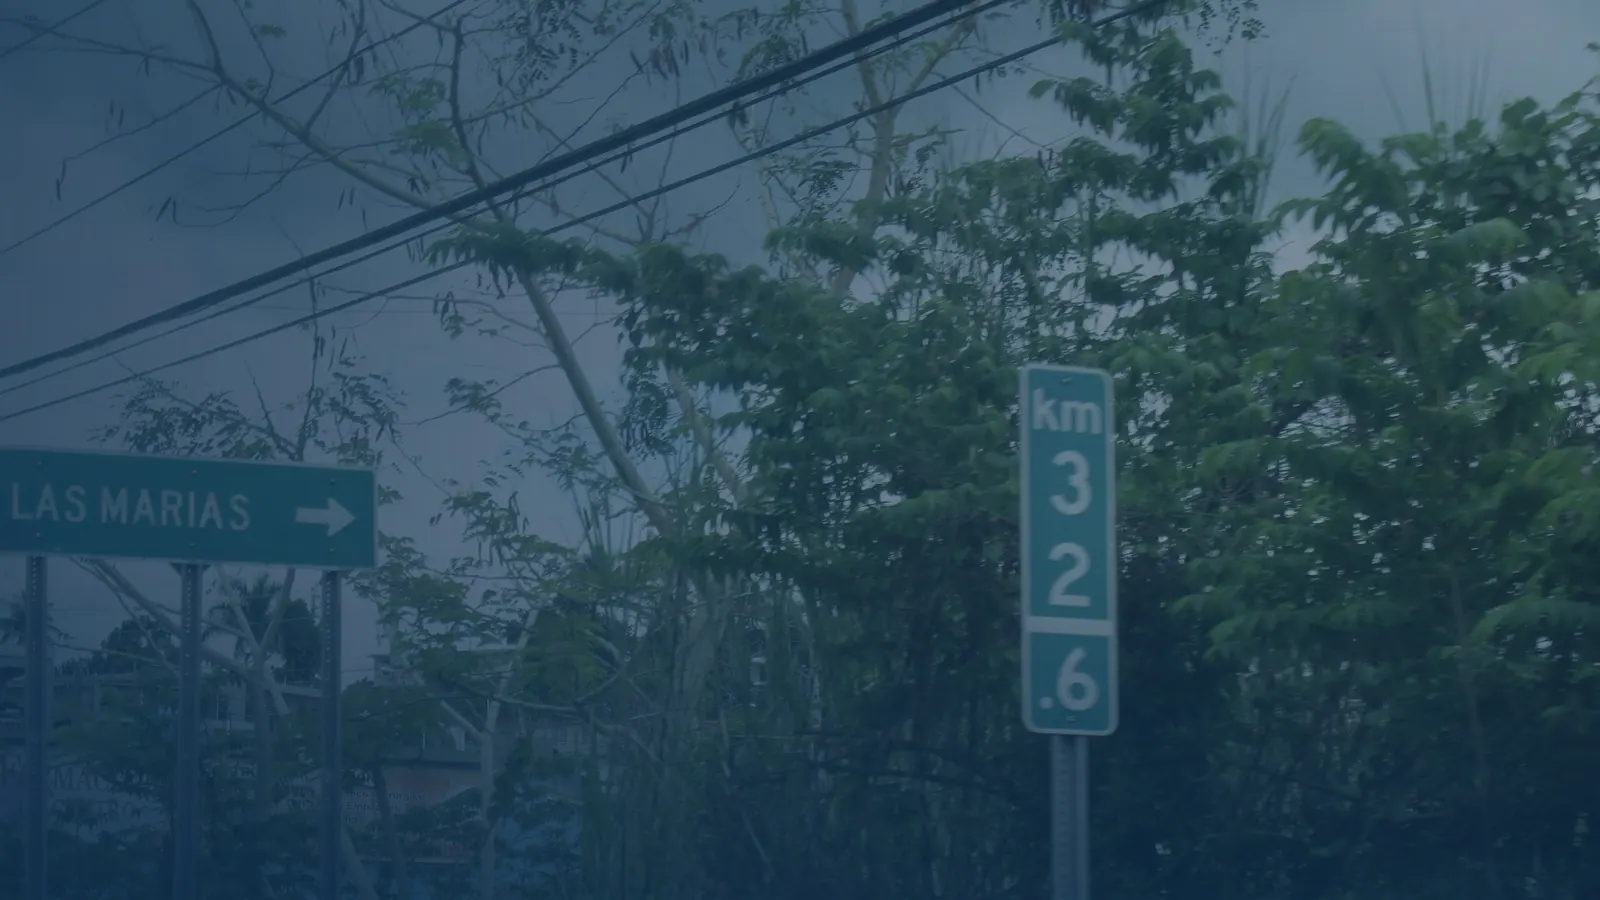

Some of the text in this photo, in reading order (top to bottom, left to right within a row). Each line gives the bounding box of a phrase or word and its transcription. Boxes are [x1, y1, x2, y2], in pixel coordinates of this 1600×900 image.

[1032, 387, 1102, 435] km
[10, 481, 251, 532] LAS MARIAS
[1050, 450, 1093, 516] 3
[1048, 542, 1092, 608] 2
